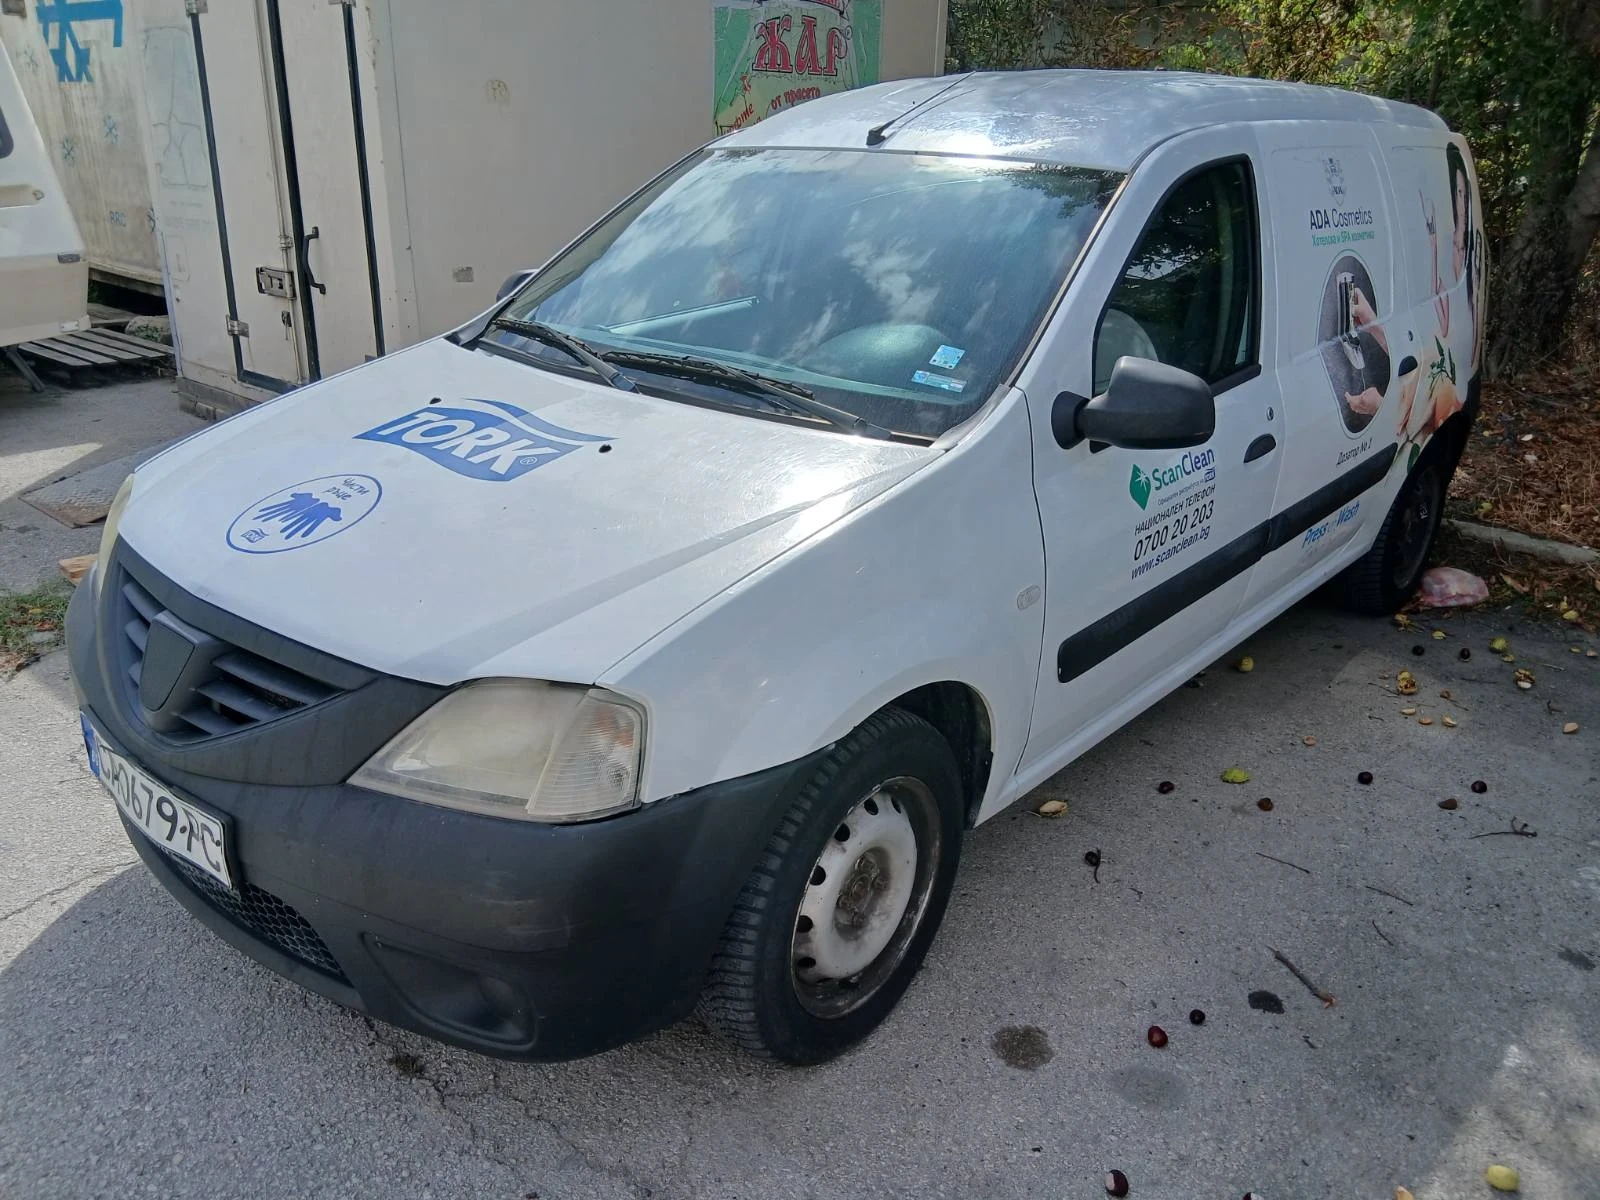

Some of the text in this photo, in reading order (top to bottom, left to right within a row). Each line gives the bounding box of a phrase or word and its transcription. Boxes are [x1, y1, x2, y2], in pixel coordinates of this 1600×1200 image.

[1310, 207, 1373, 230] ADA Cosmetics
[1152, 448, 1215, 491] ScanClean
[1133, 500, 1214, 561] 0700 20 203
[1134, 502, 1183, 536] НАЦИОНАЛЕН
[1185, 483, 1216, 511] ТЕЛЕФОН
[1131, 525, 1211, 580] www.scanclean.bg
